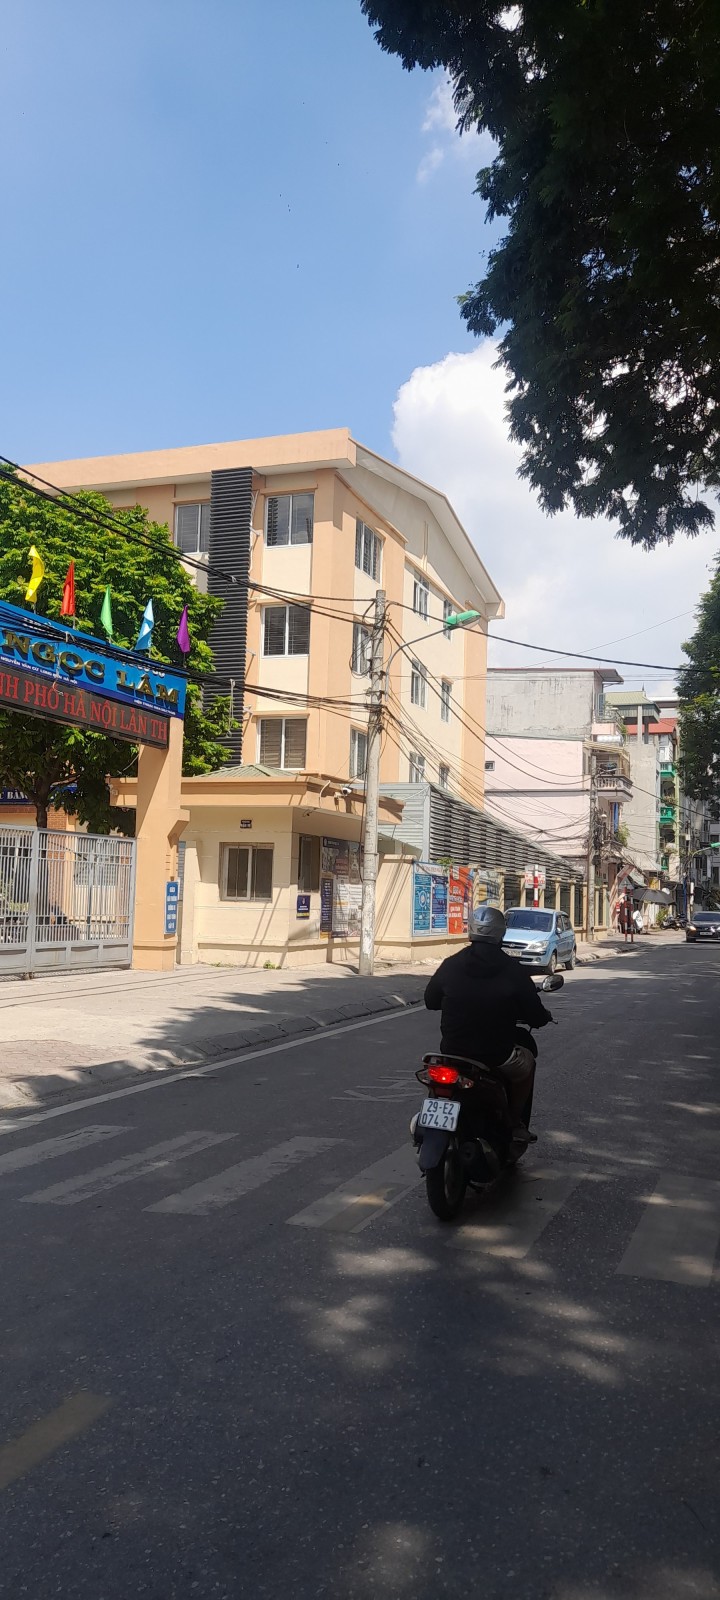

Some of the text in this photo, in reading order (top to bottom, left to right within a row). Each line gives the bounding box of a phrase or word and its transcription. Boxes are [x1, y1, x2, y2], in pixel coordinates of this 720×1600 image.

[2, 629, 105, 679] NGỌC
[117, 670, 180, 704] LÂM
[63, 689, 87, 718] HÀ
[90, 700, 117, 729] NỘI
[120, 707, 148, 735] LẦN
[421, 1113, 455, 1129] 074.21
[427, 1101, 455, 1115] 29-E2
